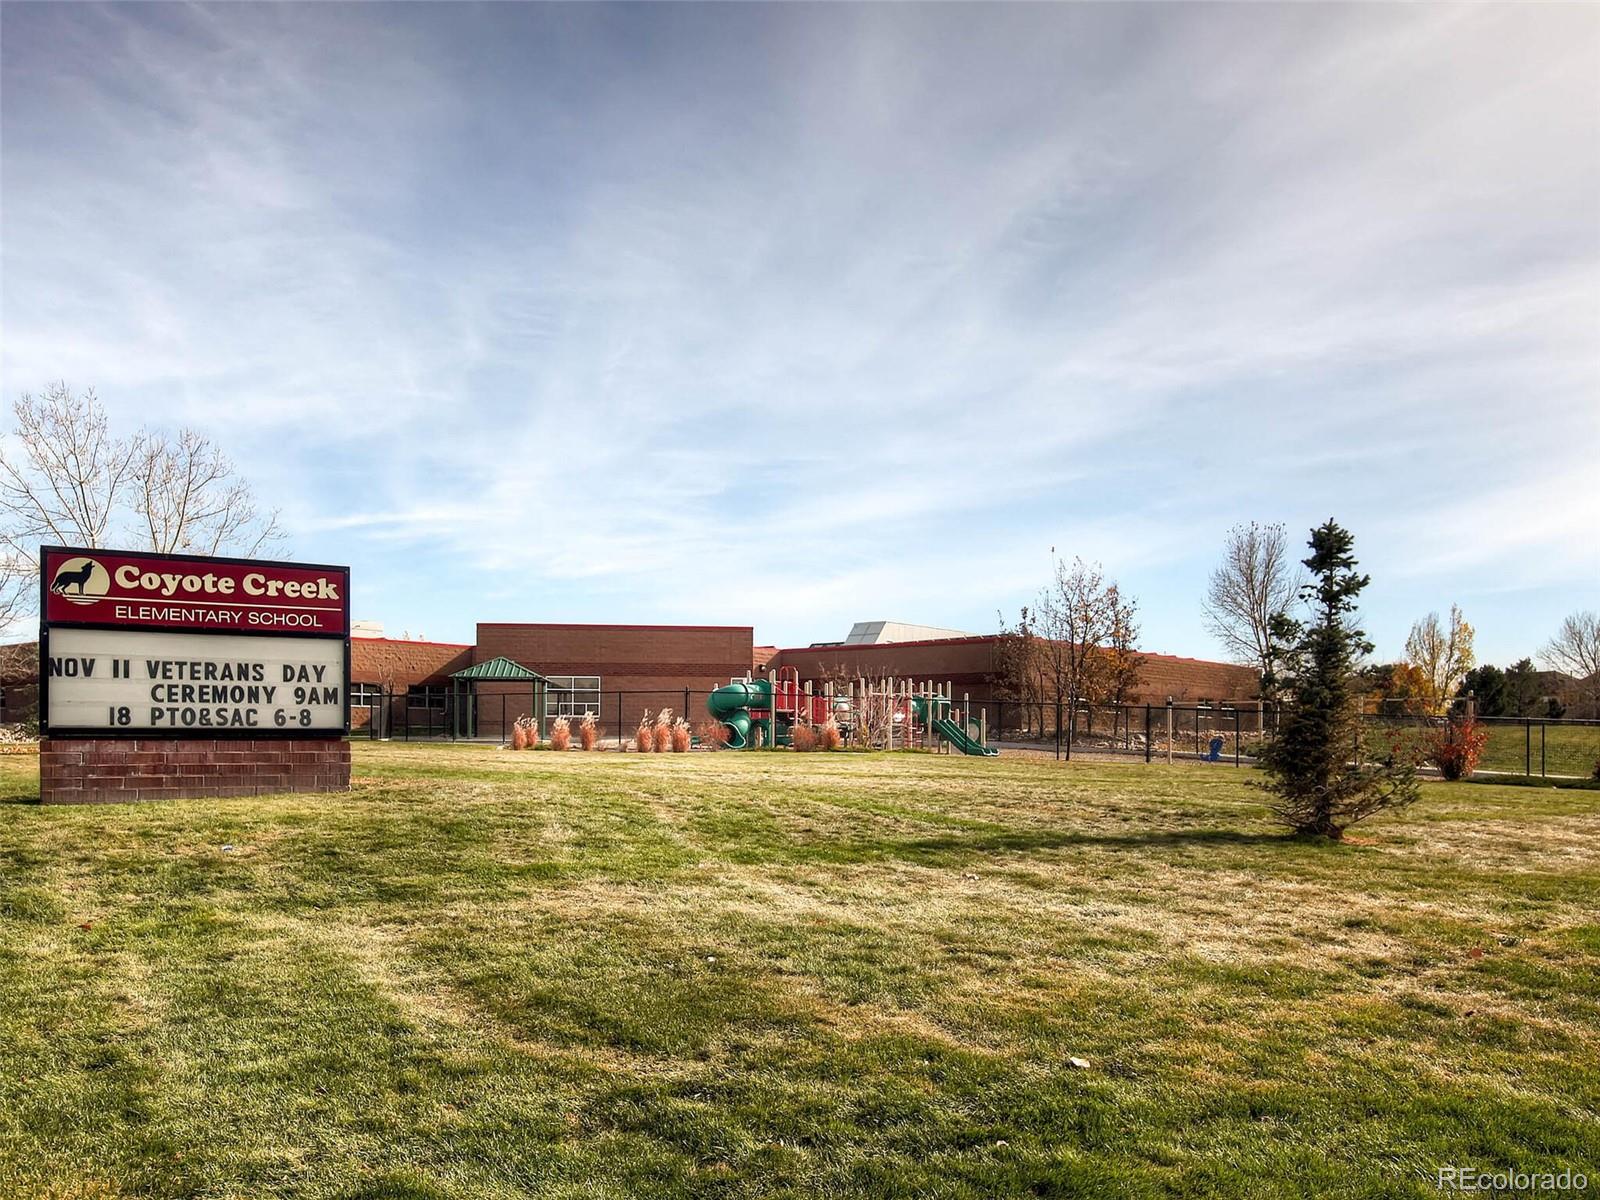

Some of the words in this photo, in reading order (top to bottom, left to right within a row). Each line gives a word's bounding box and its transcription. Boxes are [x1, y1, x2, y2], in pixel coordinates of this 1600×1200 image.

[114, 565, 235, 596] Coyote
[243, 574, 339, 600] Creek
[115, 606, 242, 623] ELEMENTARY
[248, 612, 322, 627] SCHOOL
[49, 657, 95, 677] NOV
[112, 659, 130, 679] 11
[146, 660, 264, 682] VETERANS
[282, 664, 326, 683] DAY
[151, 684, 276, 704] CEREMONY
[294, 687, 338, 705] 9AM
[109, 706, 131, 726] 18
[151, 707, 258, 726] PTO&SAC
[274, 708, 311, 727] 6-8
